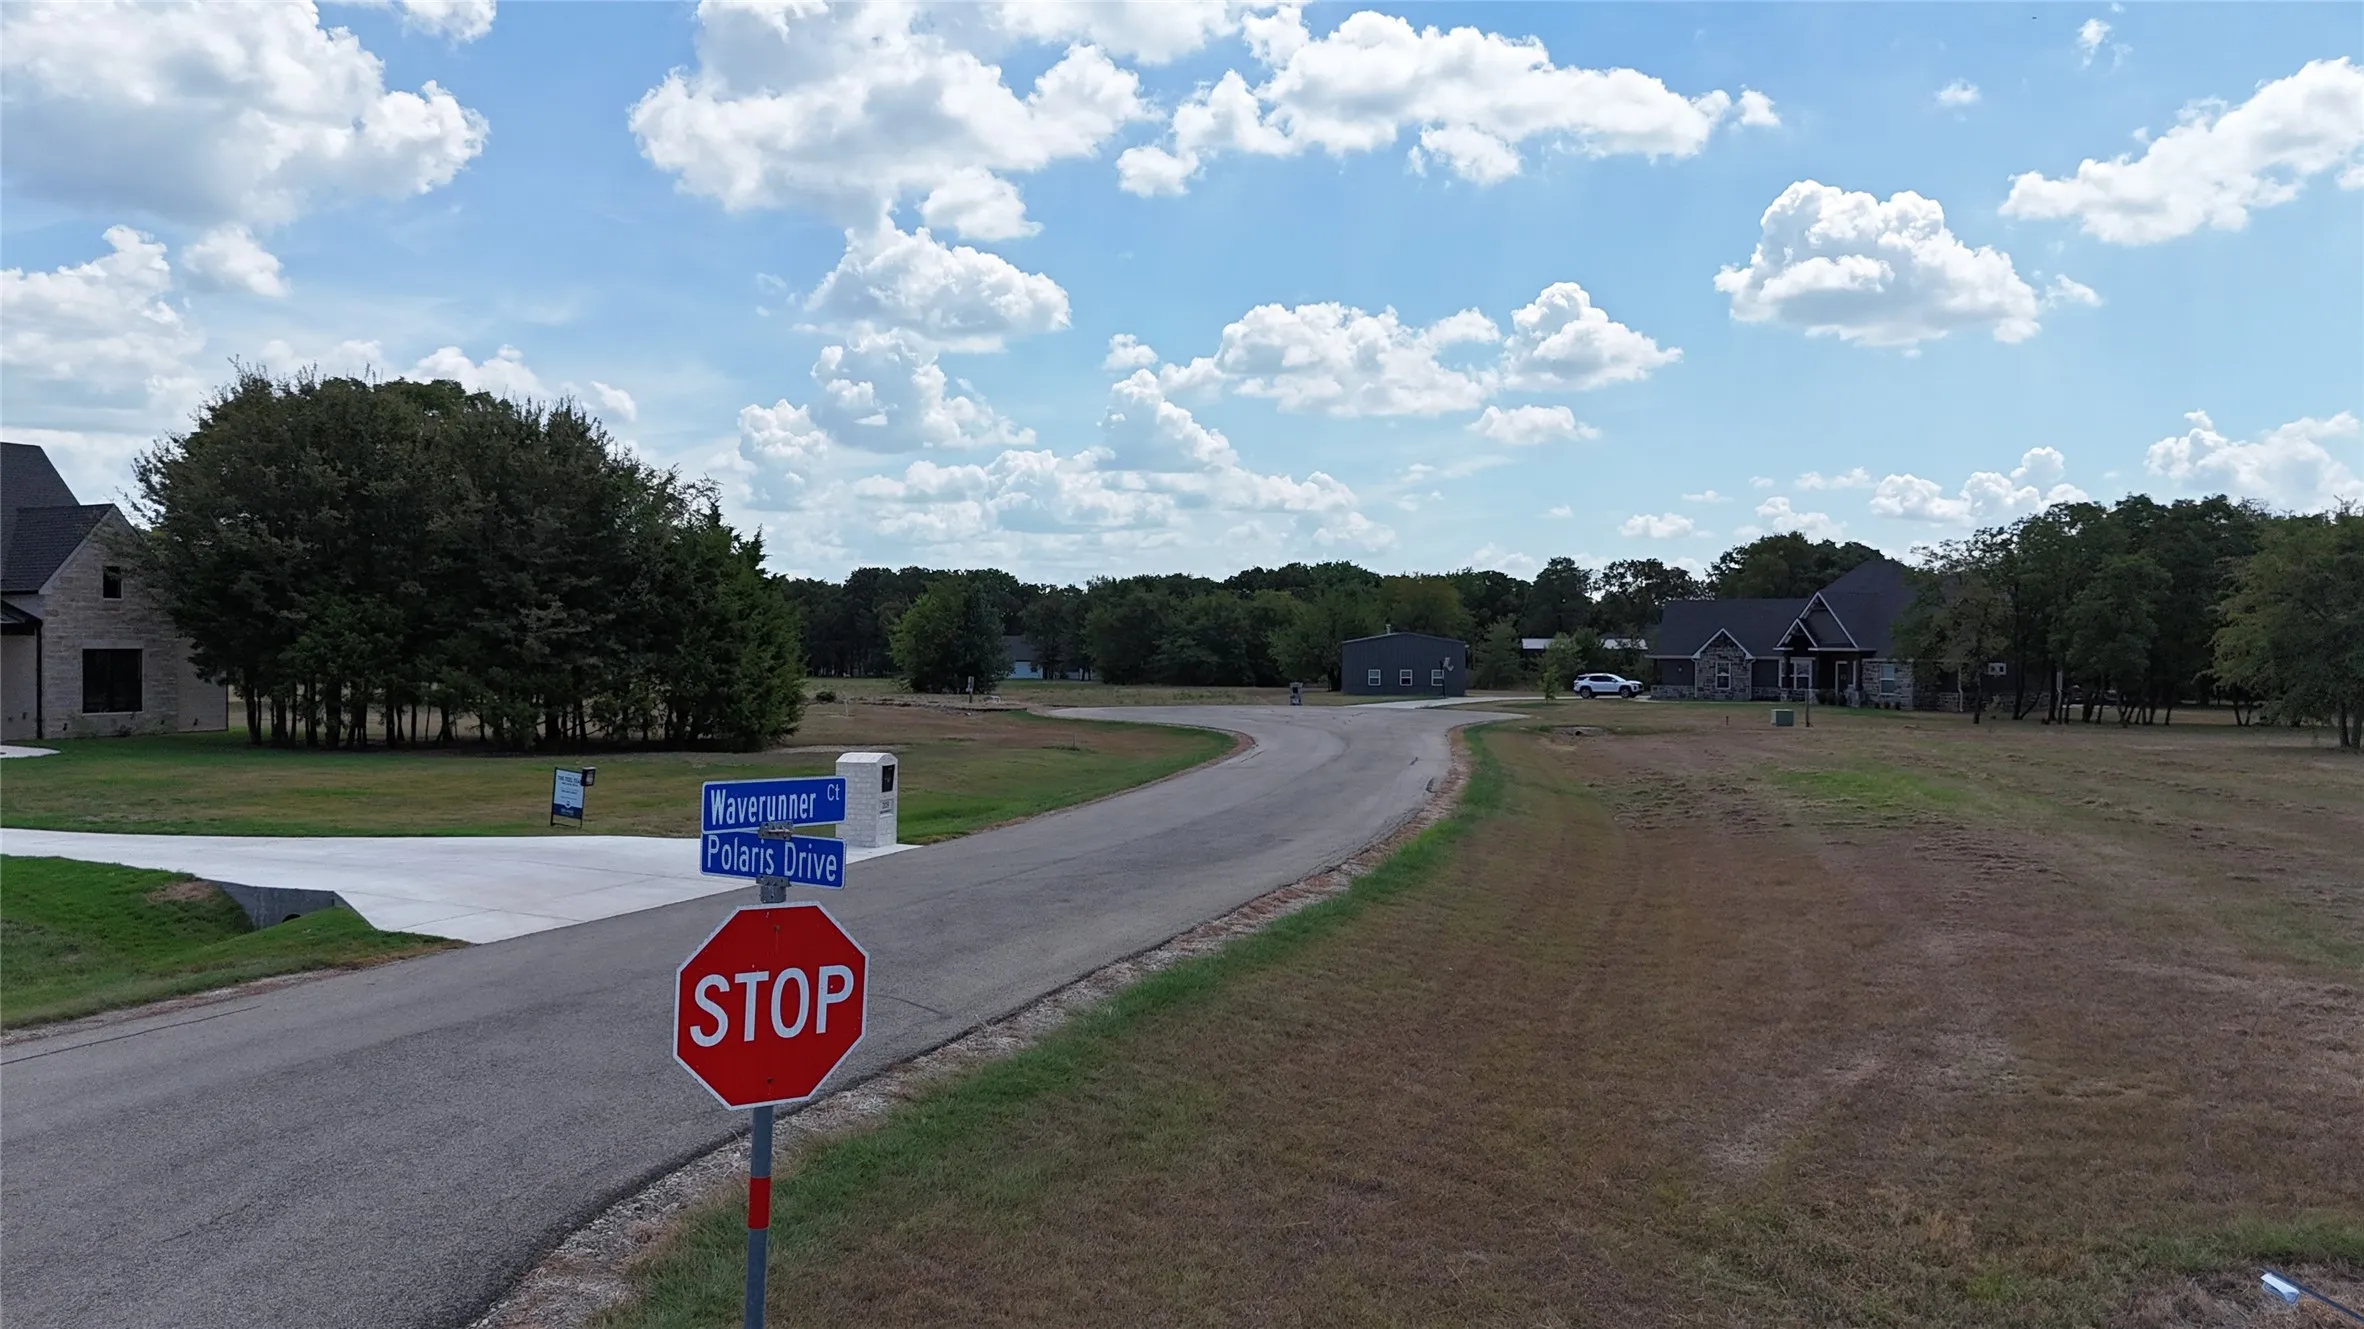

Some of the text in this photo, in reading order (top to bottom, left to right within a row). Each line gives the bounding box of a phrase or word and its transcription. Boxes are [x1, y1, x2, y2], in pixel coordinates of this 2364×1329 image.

[710, 783, 840, 826] Waverunner Ct
[707, 835, 837, 882] Polaris Drive
[689, 964, 855, 1048] STOP
